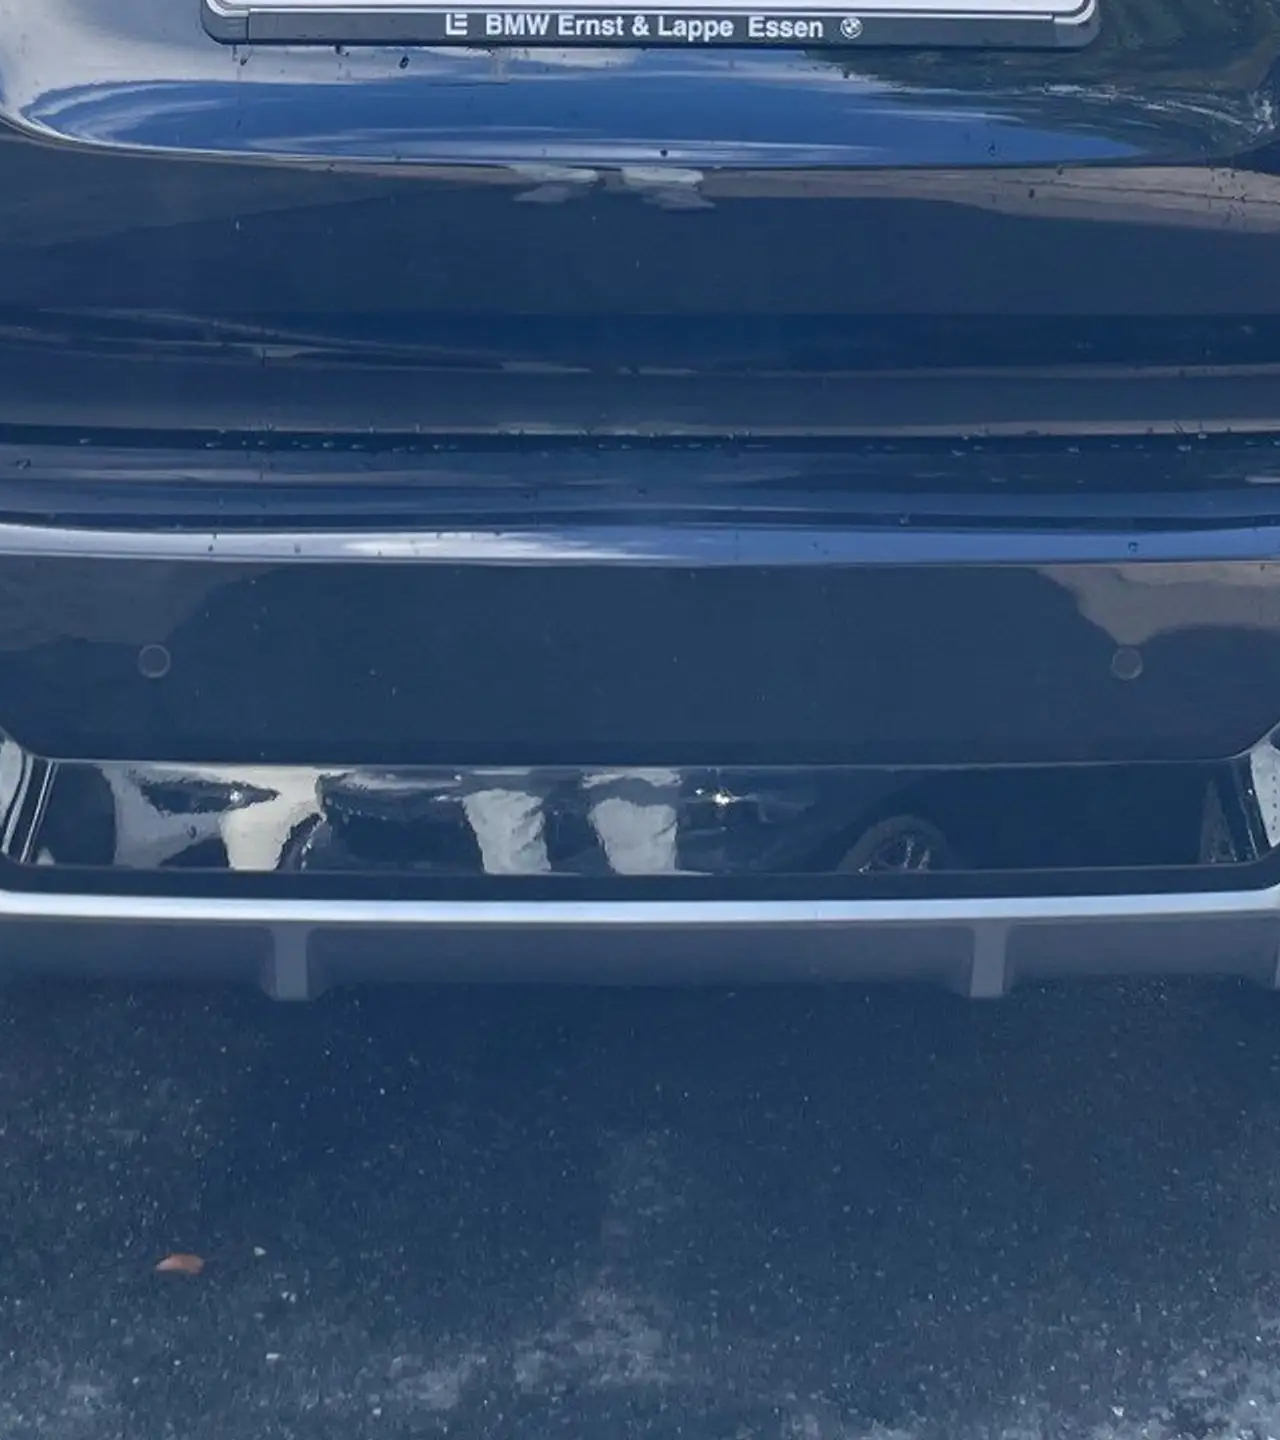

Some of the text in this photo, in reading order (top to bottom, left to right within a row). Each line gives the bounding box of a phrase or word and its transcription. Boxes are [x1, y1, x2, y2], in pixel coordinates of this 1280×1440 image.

[485, 14, 550, 37] BMW
[557, 15, 624, 38] Ernst
[631, 16, 650, 37] &
[658, 16, 735, 43] Lappe
[748, 17, 824, 39] Essen
